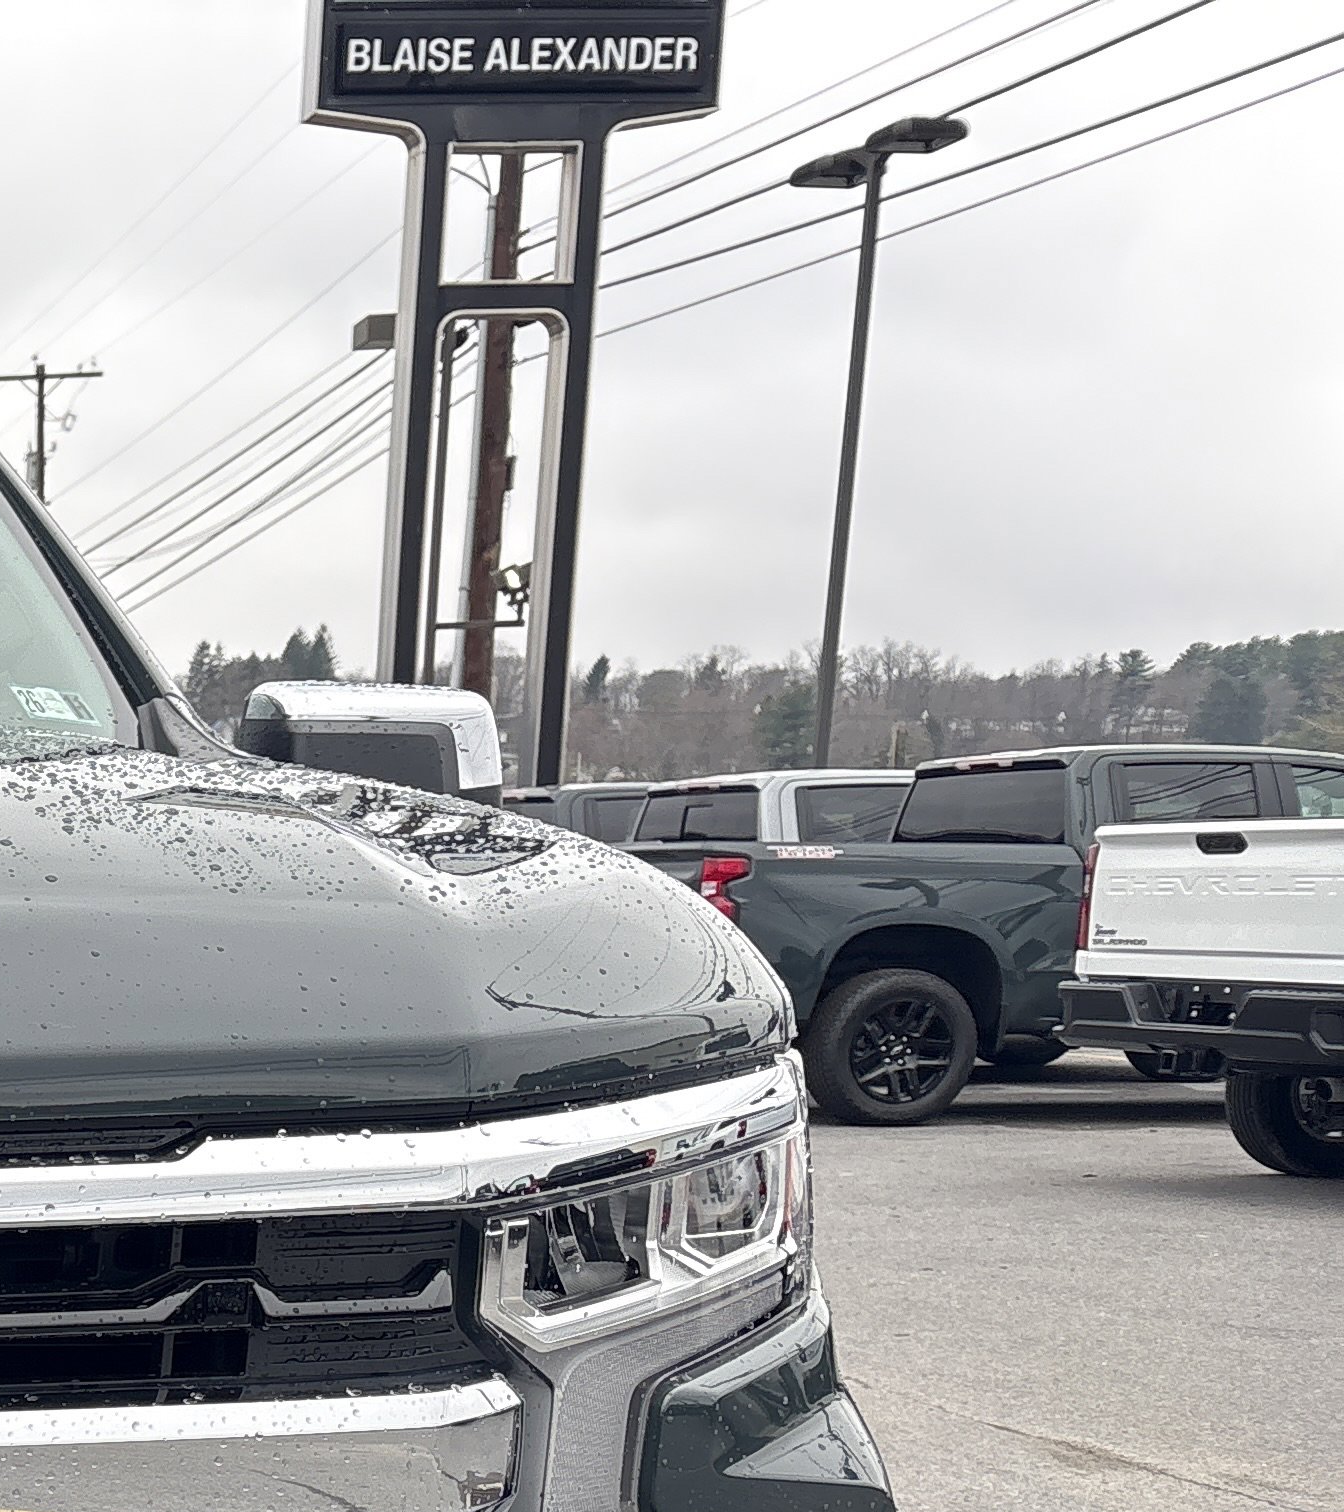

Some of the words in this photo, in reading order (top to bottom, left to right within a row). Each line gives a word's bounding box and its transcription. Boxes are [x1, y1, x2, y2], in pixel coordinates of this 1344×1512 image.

[346, 38, 475, 72] BLAISE
[483, 36, 699, 72] ALEXANDER
[1106, 874, 1344, 896] CHEVROLET
